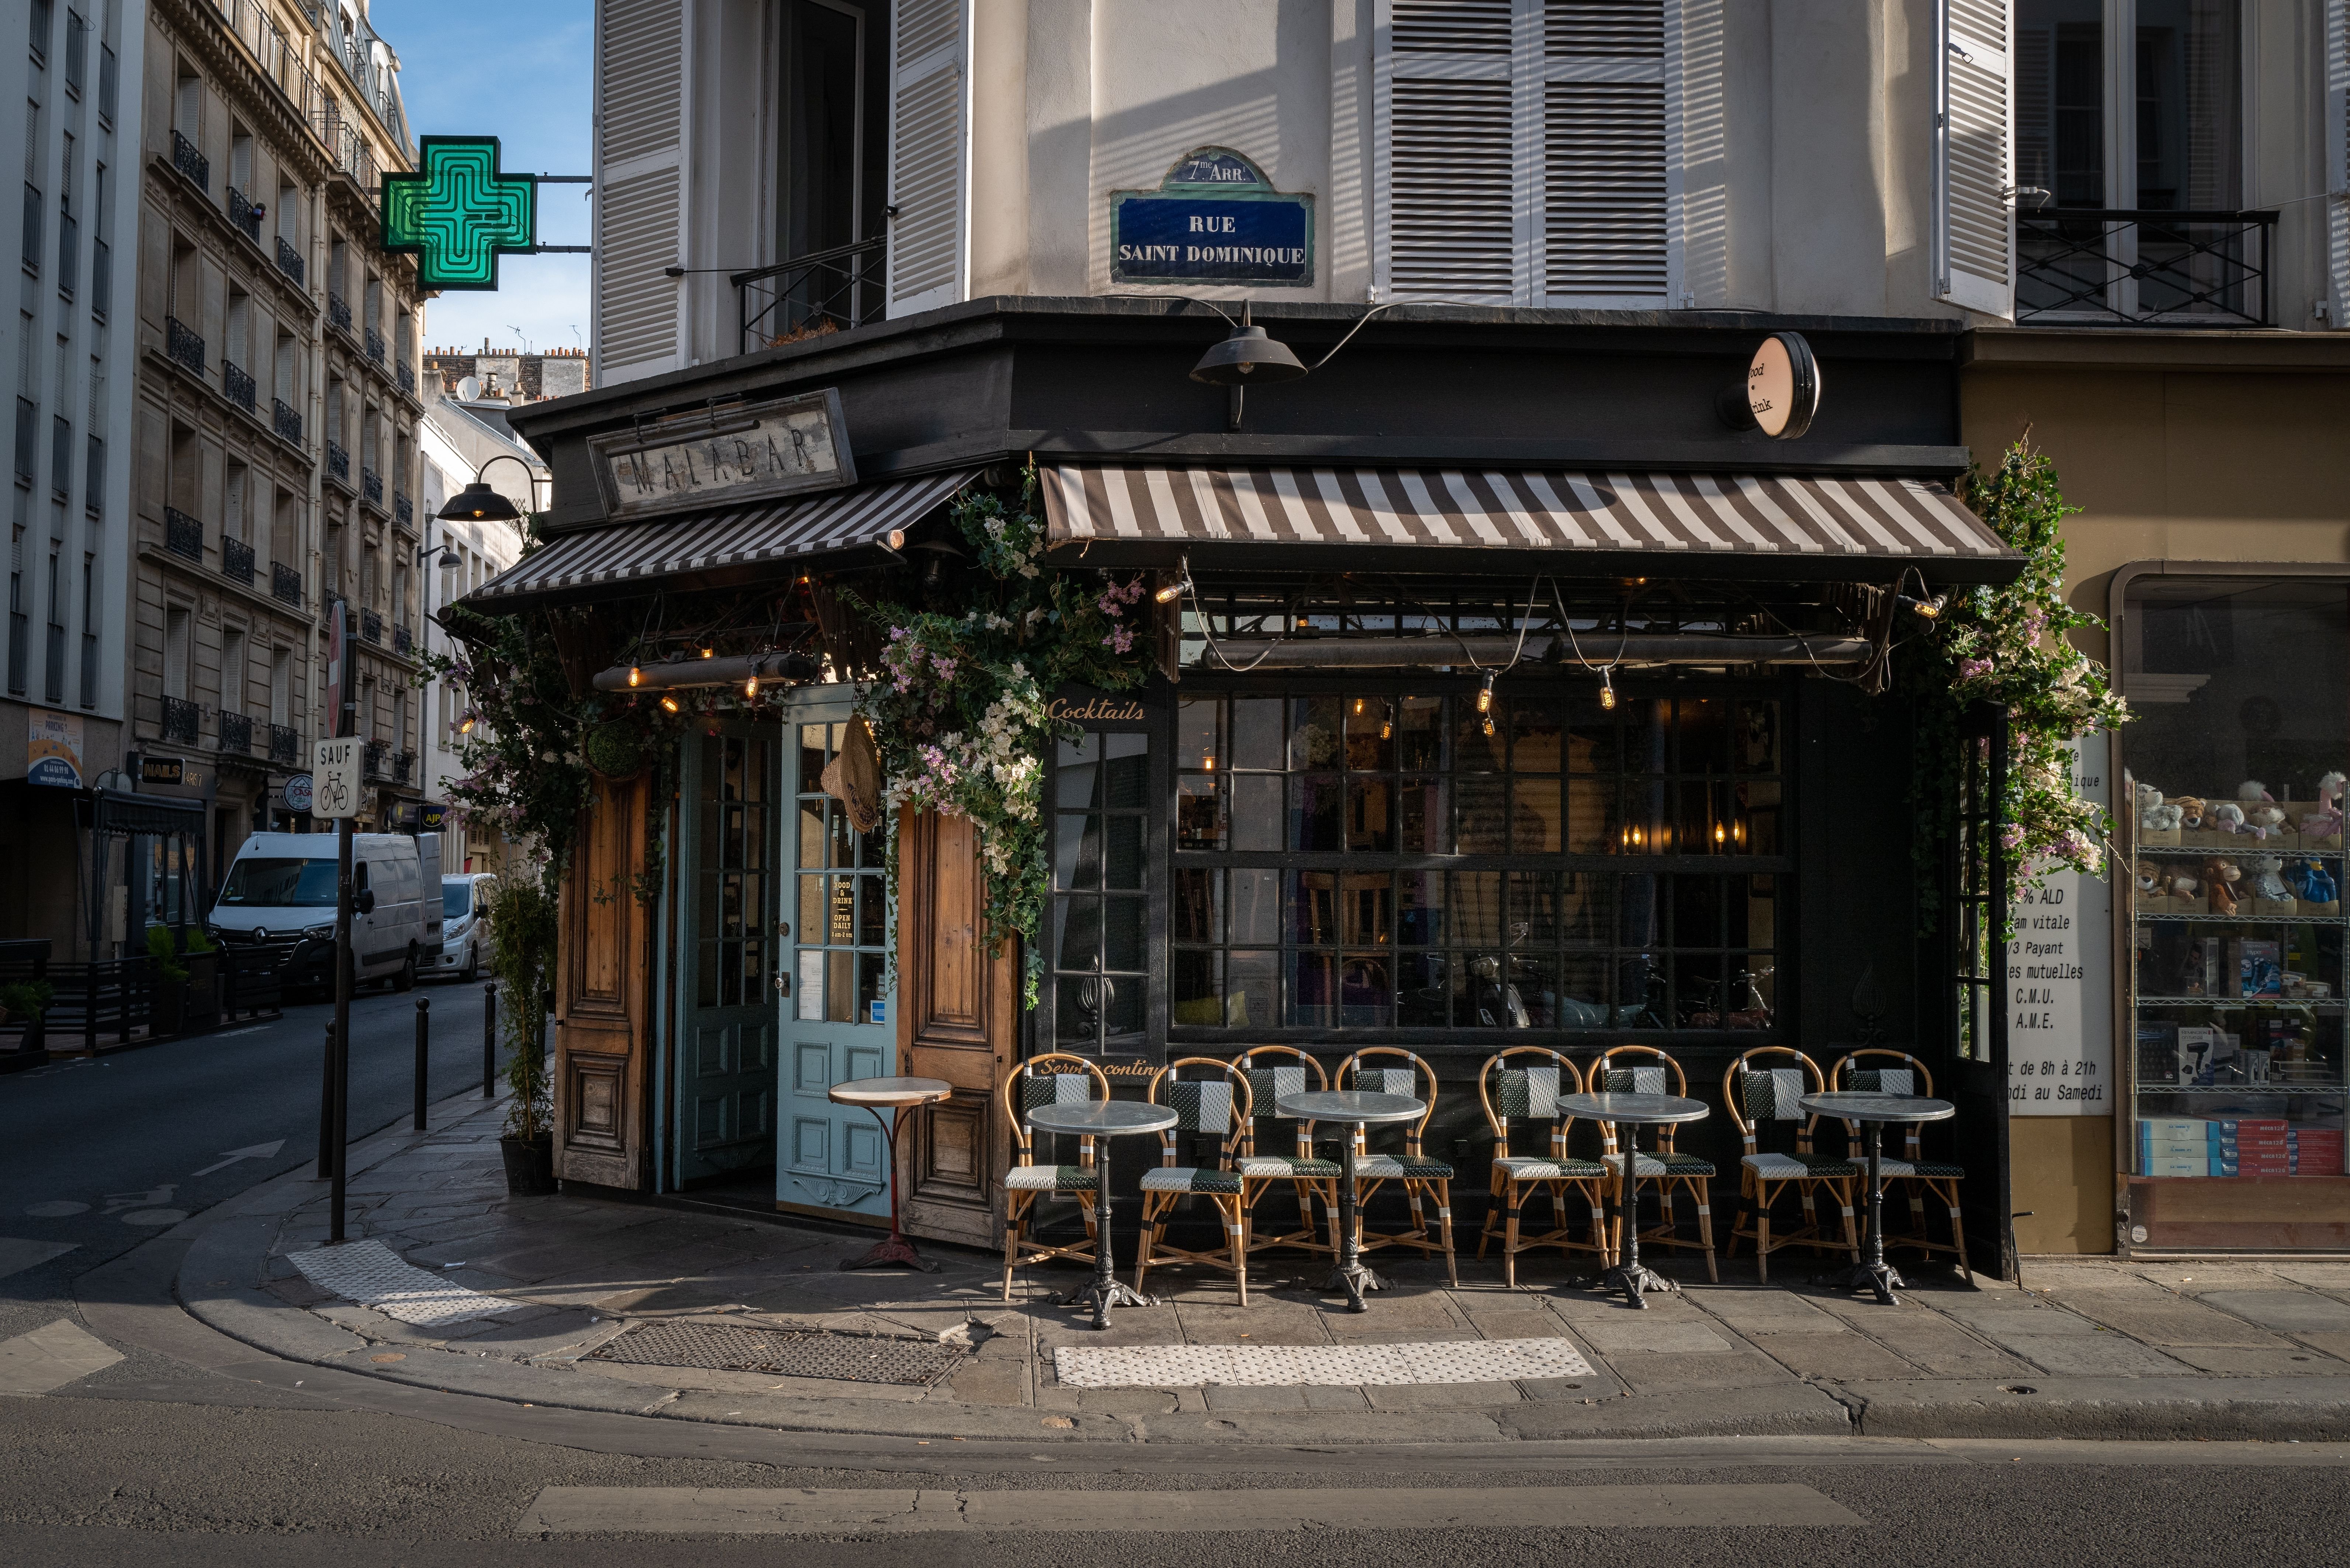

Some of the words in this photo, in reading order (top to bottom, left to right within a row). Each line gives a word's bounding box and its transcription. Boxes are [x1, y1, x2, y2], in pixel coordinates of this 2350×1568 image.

[1189, 216, 1235, 233] RUE
[1119, 244, 1179, 261] SAINT
[1187, 246, 1304, 267] DOMINIQUE
[1750, 399, 1773, 415] rink
[629, 429, 811, 495] MALABAR
[1047, 697, 1146, 719] Cocktails
[45, 720, 63, 732] PARKING
[65, 723, 67, 733] ?
[321, 745, 350, 765] SAUF
[44, 764, 48, 772] 01
[54, 765, 59, 773] 06
[143, 763, 180, 778] NAILS
[425, 814, 441, 824] AJP
[2040, 889, 2063, 904] ALD
[2014, 918, 2027, 929] am
[2034, 915, 2069, 929] vitale
[2025, 942, 2063, 957] Payant
[2007, 966, 2021, 978] es
[2027, 964, 2083, 979] mutuelles
[2016, 988, 2054, 1004] C.M.U.
[2016, 1013, 2053, 1029] A.M.E.
[2021, 1061, 2034, 1075] de
[2041, 1061, 2055, 1075] 8h
[2062, 1060, 2068, 1075] à
[2075, 1061, 2095, 1075] 21h
[2035, 1087, 2050, 1100] au
[2057, 1085, 2102, 1100] Samedi
